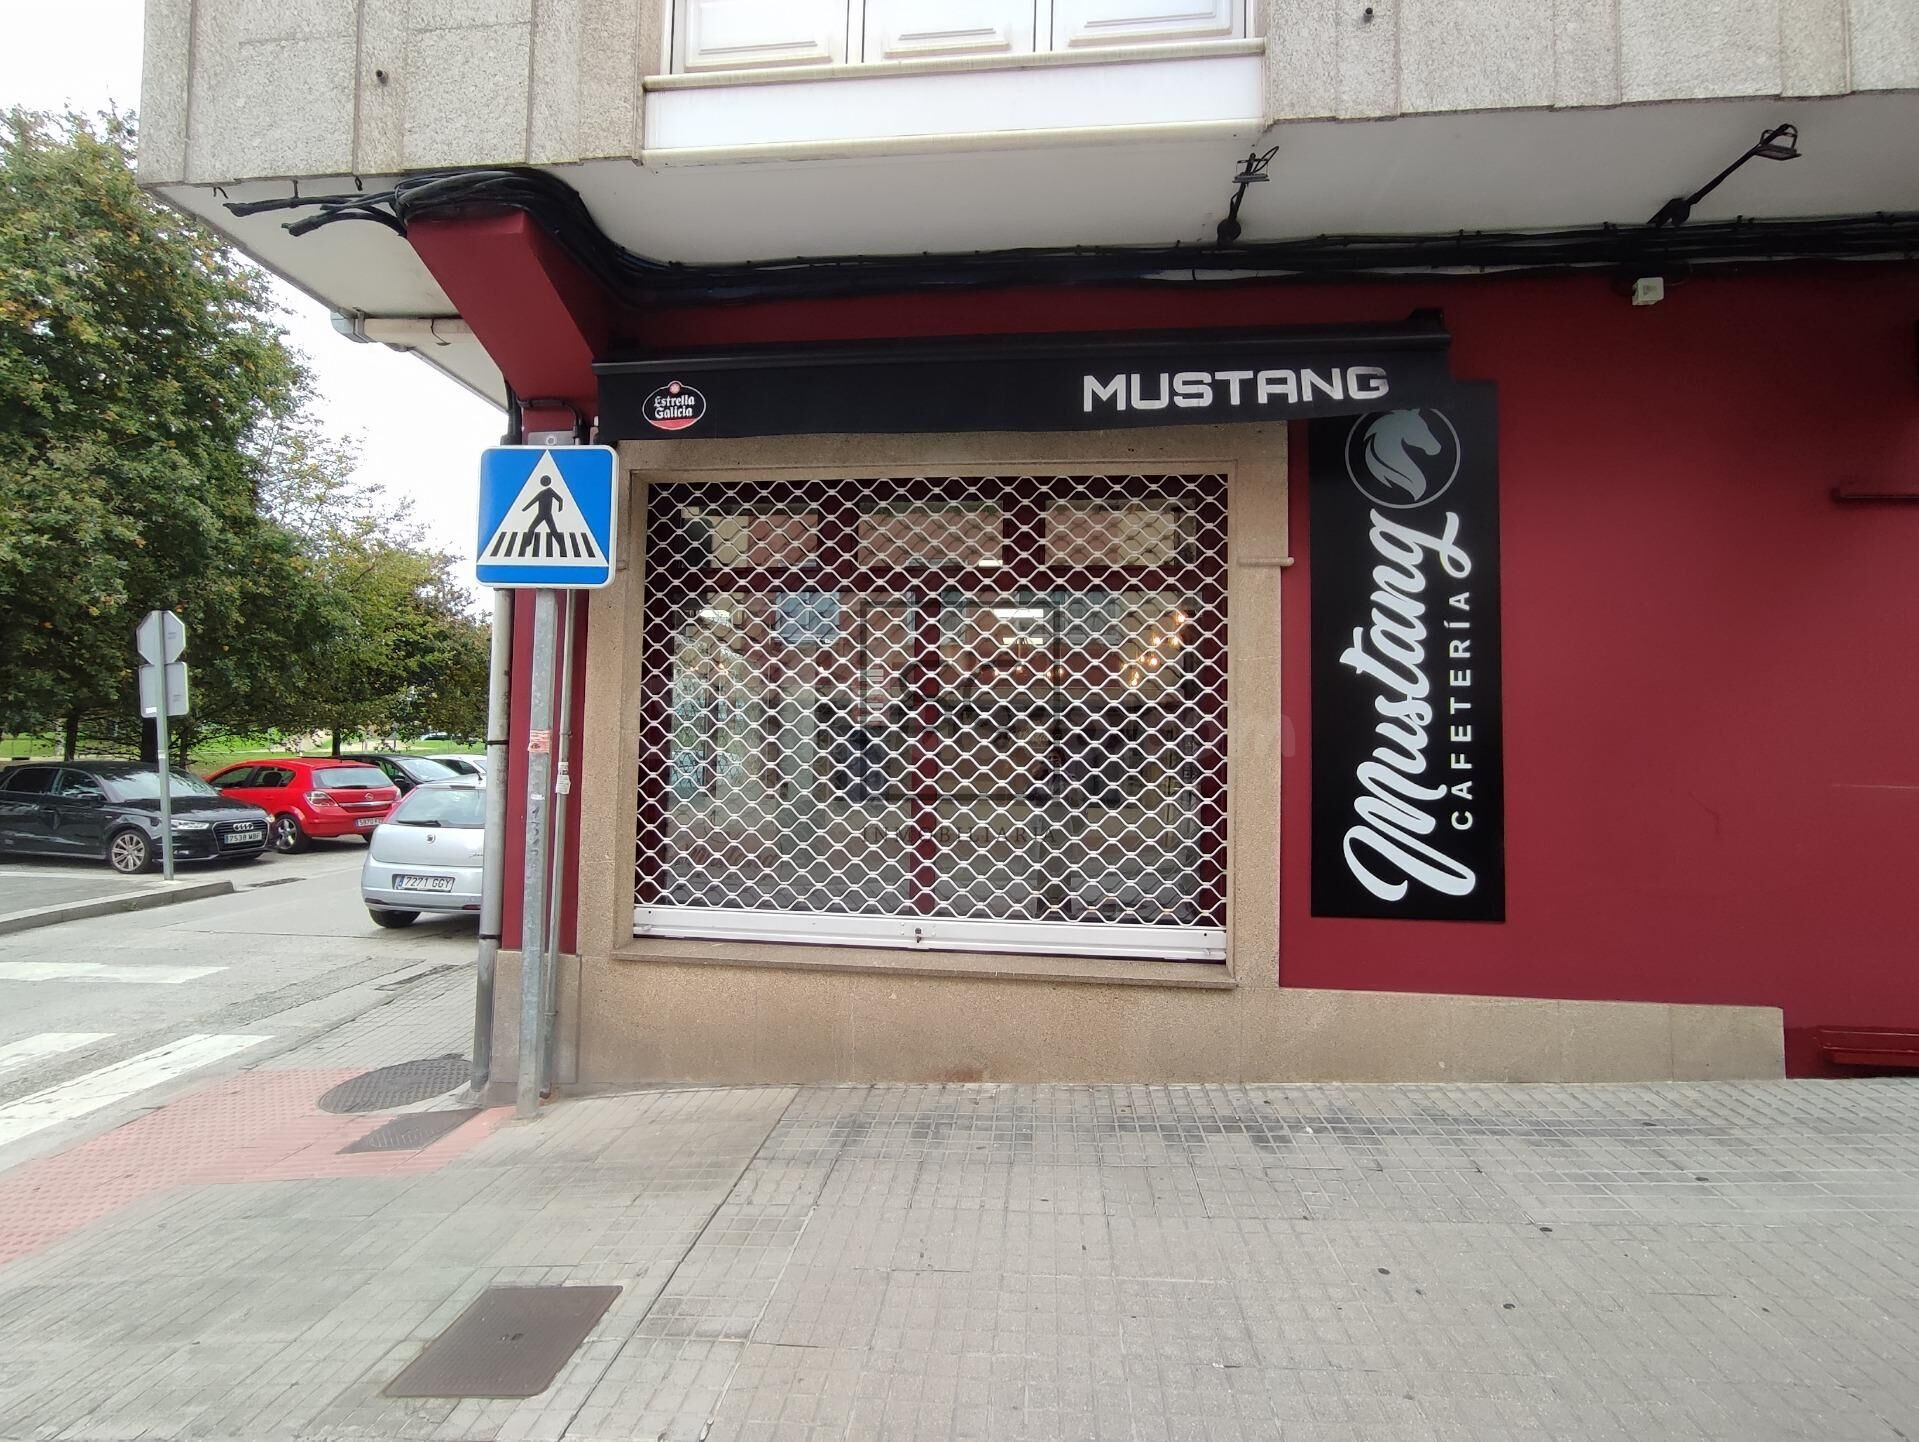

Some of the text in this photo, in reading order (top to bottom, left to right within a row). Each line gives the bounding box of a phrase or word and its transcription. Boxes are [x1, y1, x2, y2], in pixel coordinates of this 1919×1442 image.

[653, 394, 696, 407] Estrella
[1083, 364, 1390, 413] MUSTANG
[654, 405, 693, 419] Galicia
[1339, 508, 1477, 902] Mustang
[1445, 590, 1474, 831] CAFETERÍA
[404, 876, 451, 889] 7271 GGY
